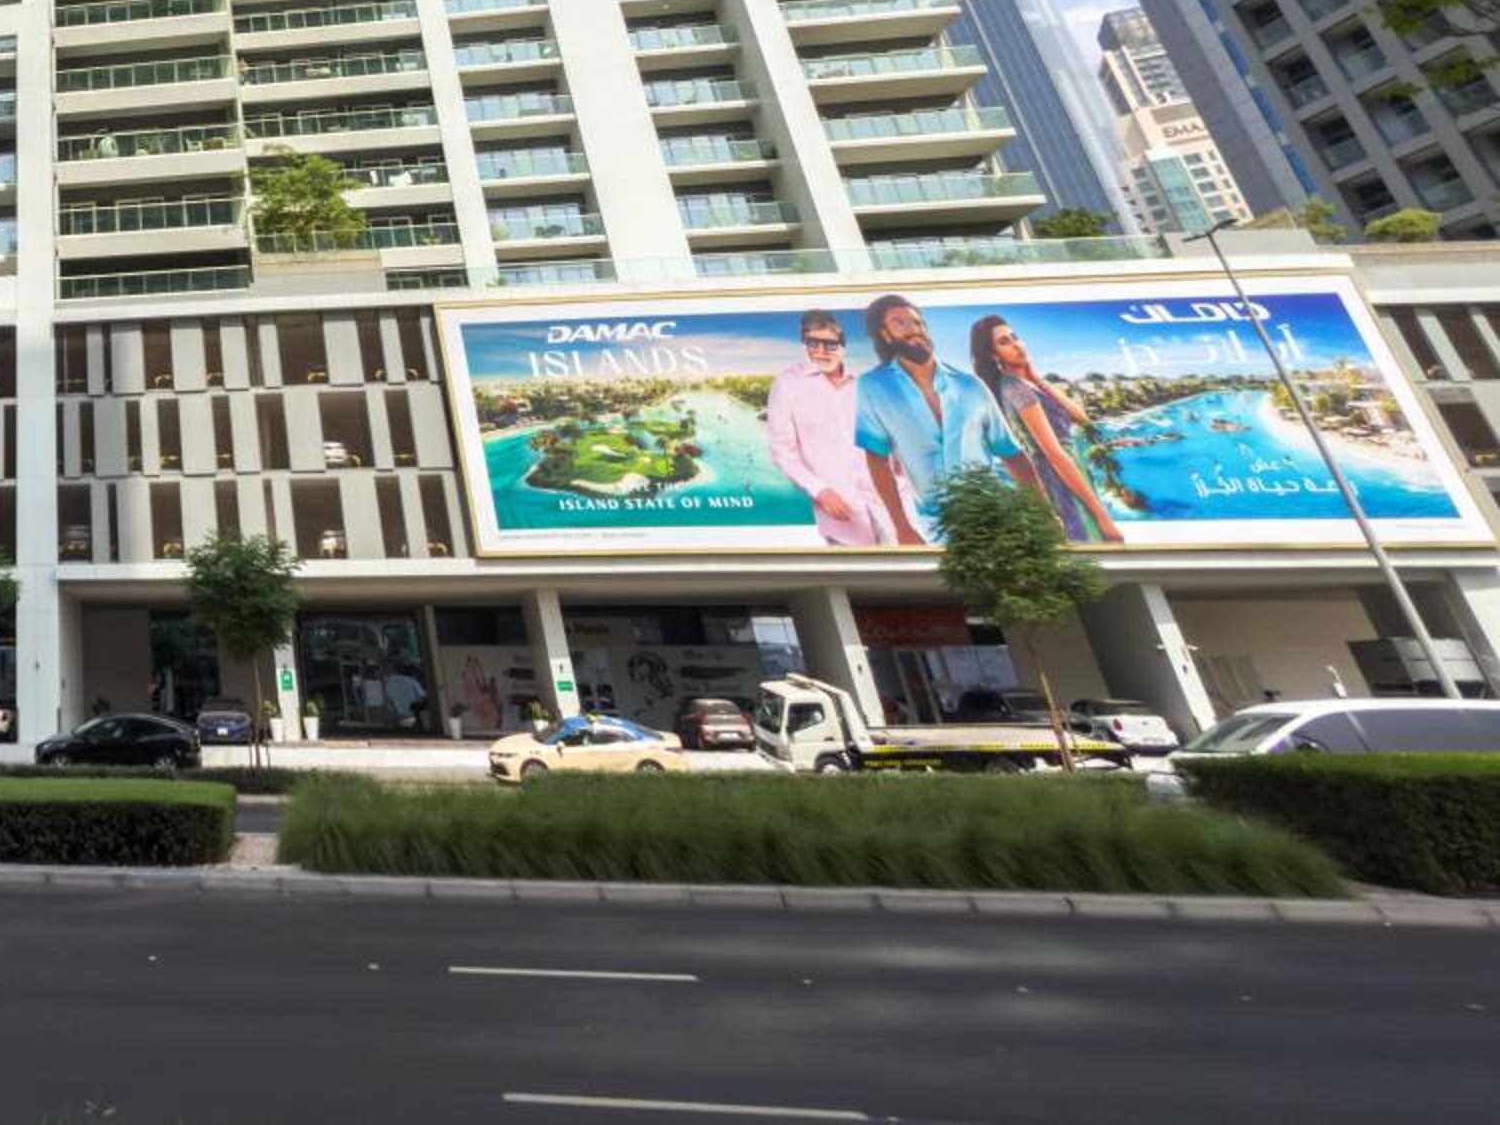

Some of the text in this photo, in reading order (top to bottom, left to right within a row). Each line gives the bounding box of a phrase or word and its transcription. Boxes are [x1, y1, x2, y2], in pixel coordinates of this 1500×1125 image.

[547, 321, 676, 343] DAMAC
[528, 345, 709, 377] ISLANDS
[559, 496, 754, 511] ISLAND STATE OF MIND
